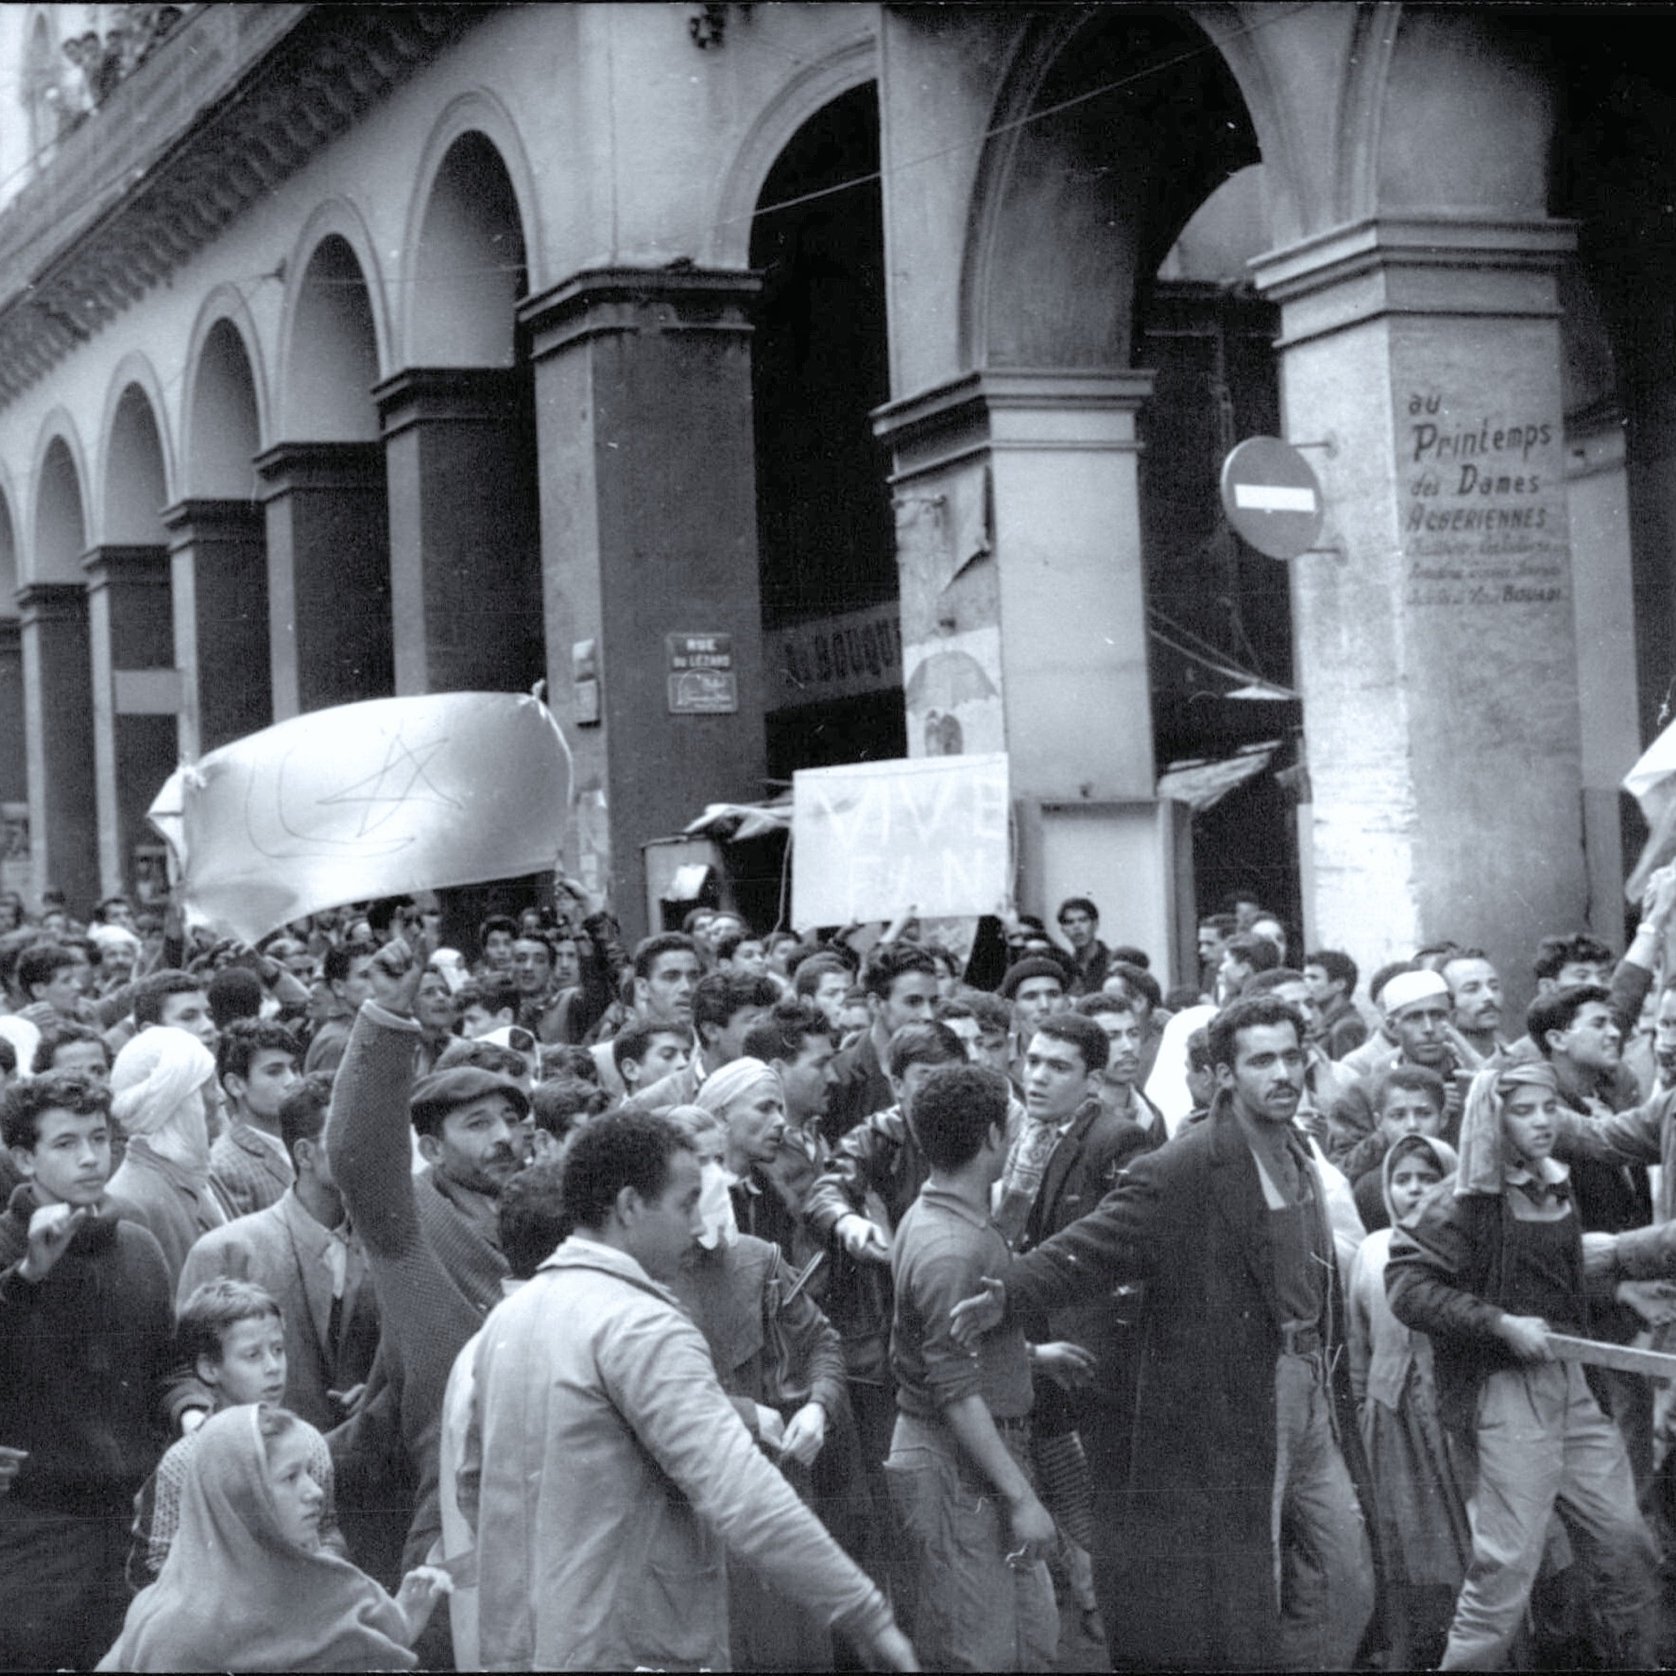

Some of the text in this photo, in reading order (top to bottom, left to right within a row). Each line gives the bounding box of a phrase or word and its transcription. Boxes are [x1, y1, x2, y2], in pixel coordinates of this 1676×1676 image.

[1412, 418, 1552, 462] Printemps
[1410, 464, 1540, 497] des Dames
[686, 638, 717, 651] RUE
[812, 773, 1004, 850] VIVE
